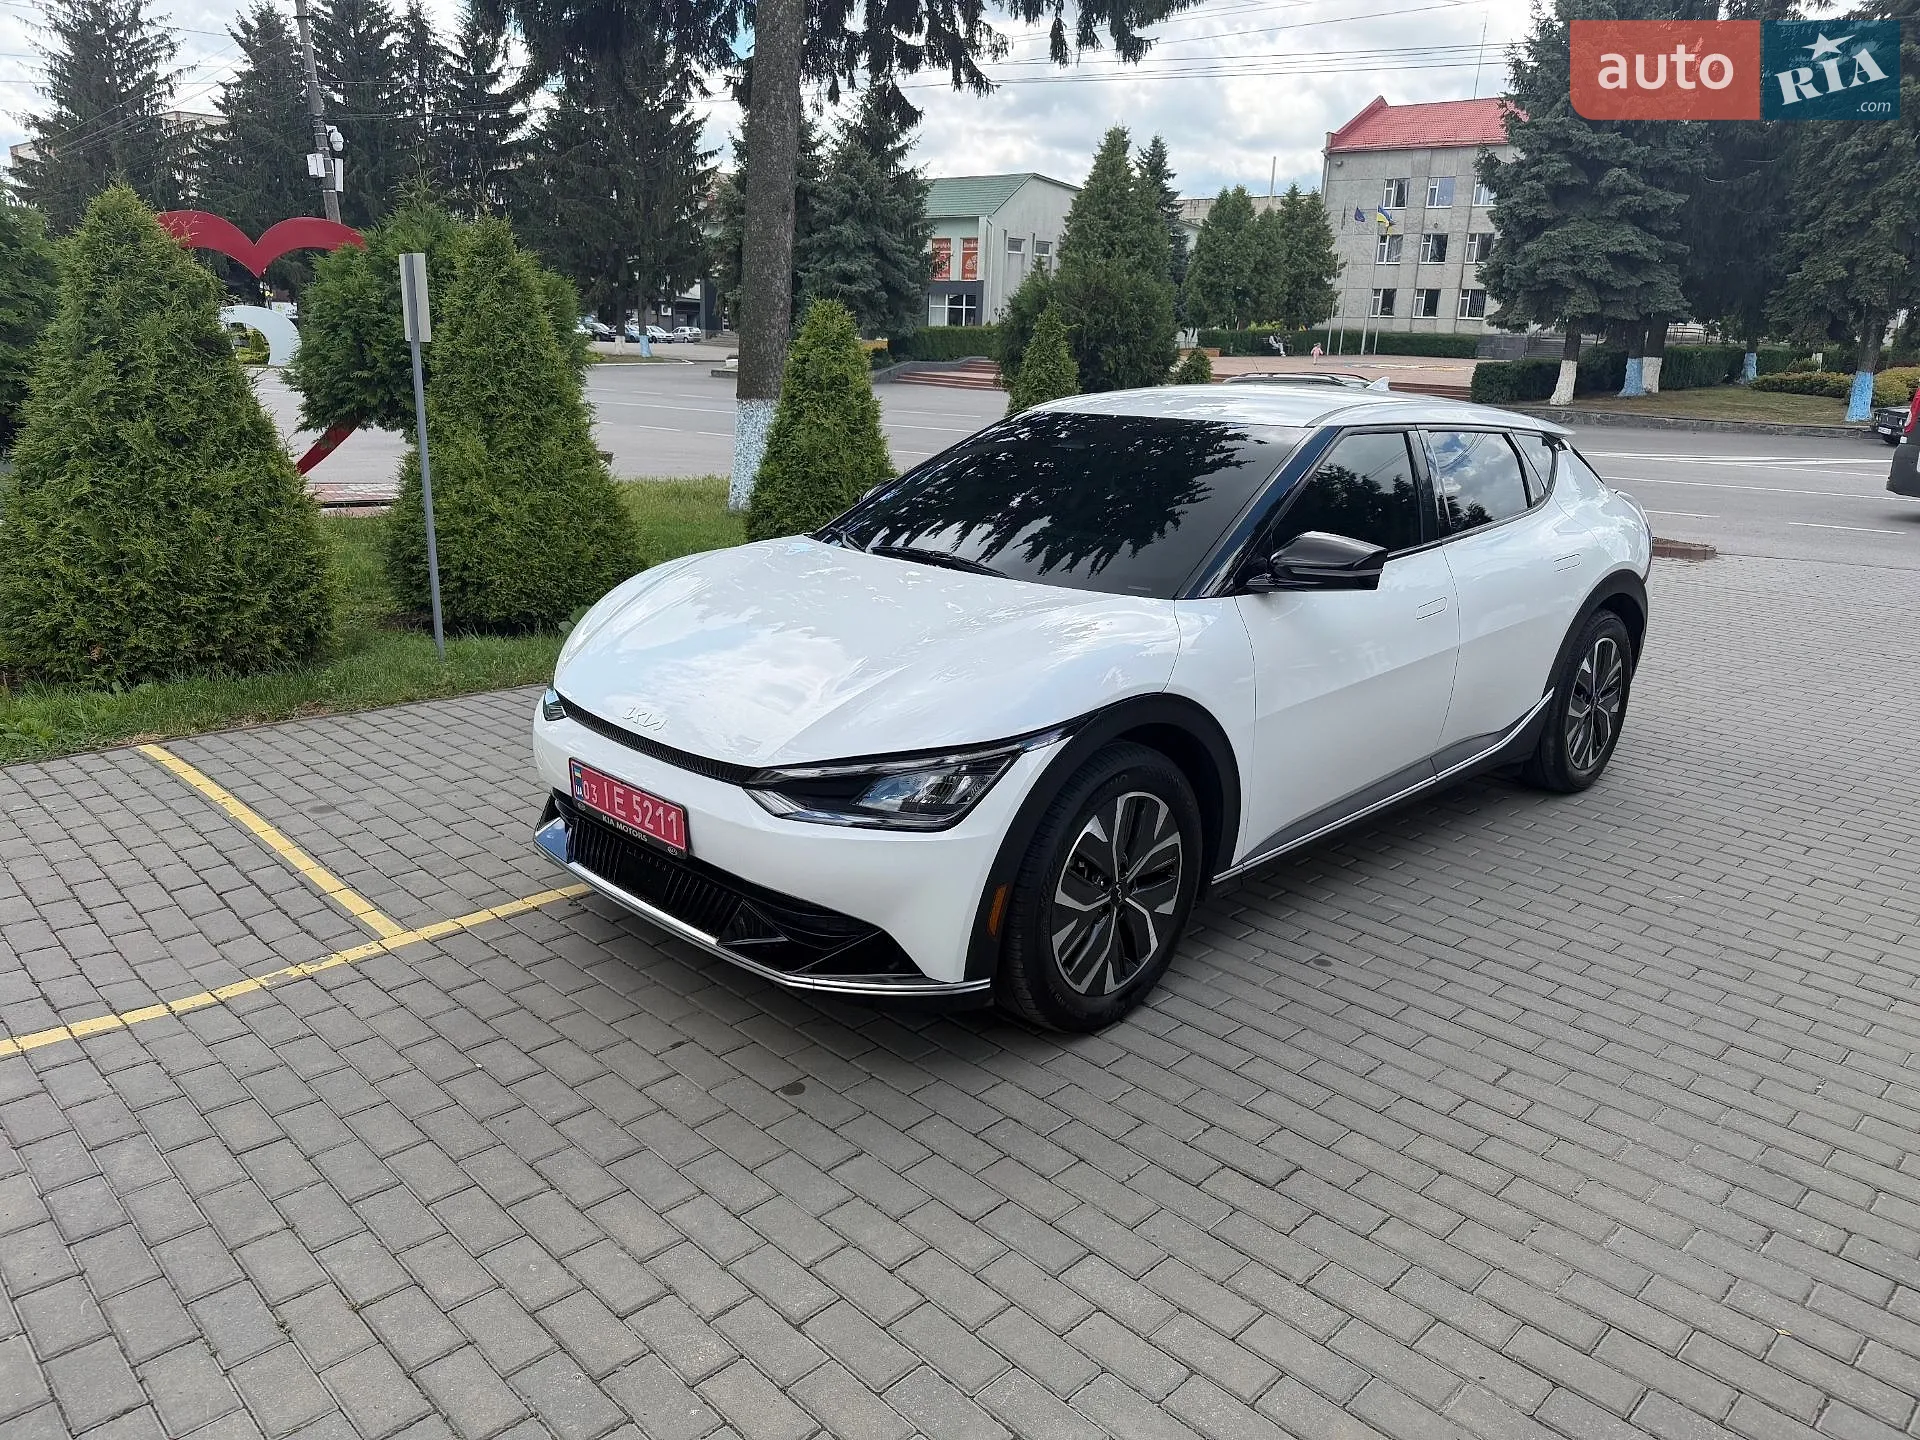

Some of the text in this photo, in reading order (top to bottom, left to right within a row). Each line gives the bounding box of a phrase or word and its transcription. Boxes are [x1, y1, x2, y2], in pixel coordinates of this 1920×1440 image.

[583, 780, 678, 841] 03 IE 5211
[602, 814, 648, 842] KIA MOTORS
